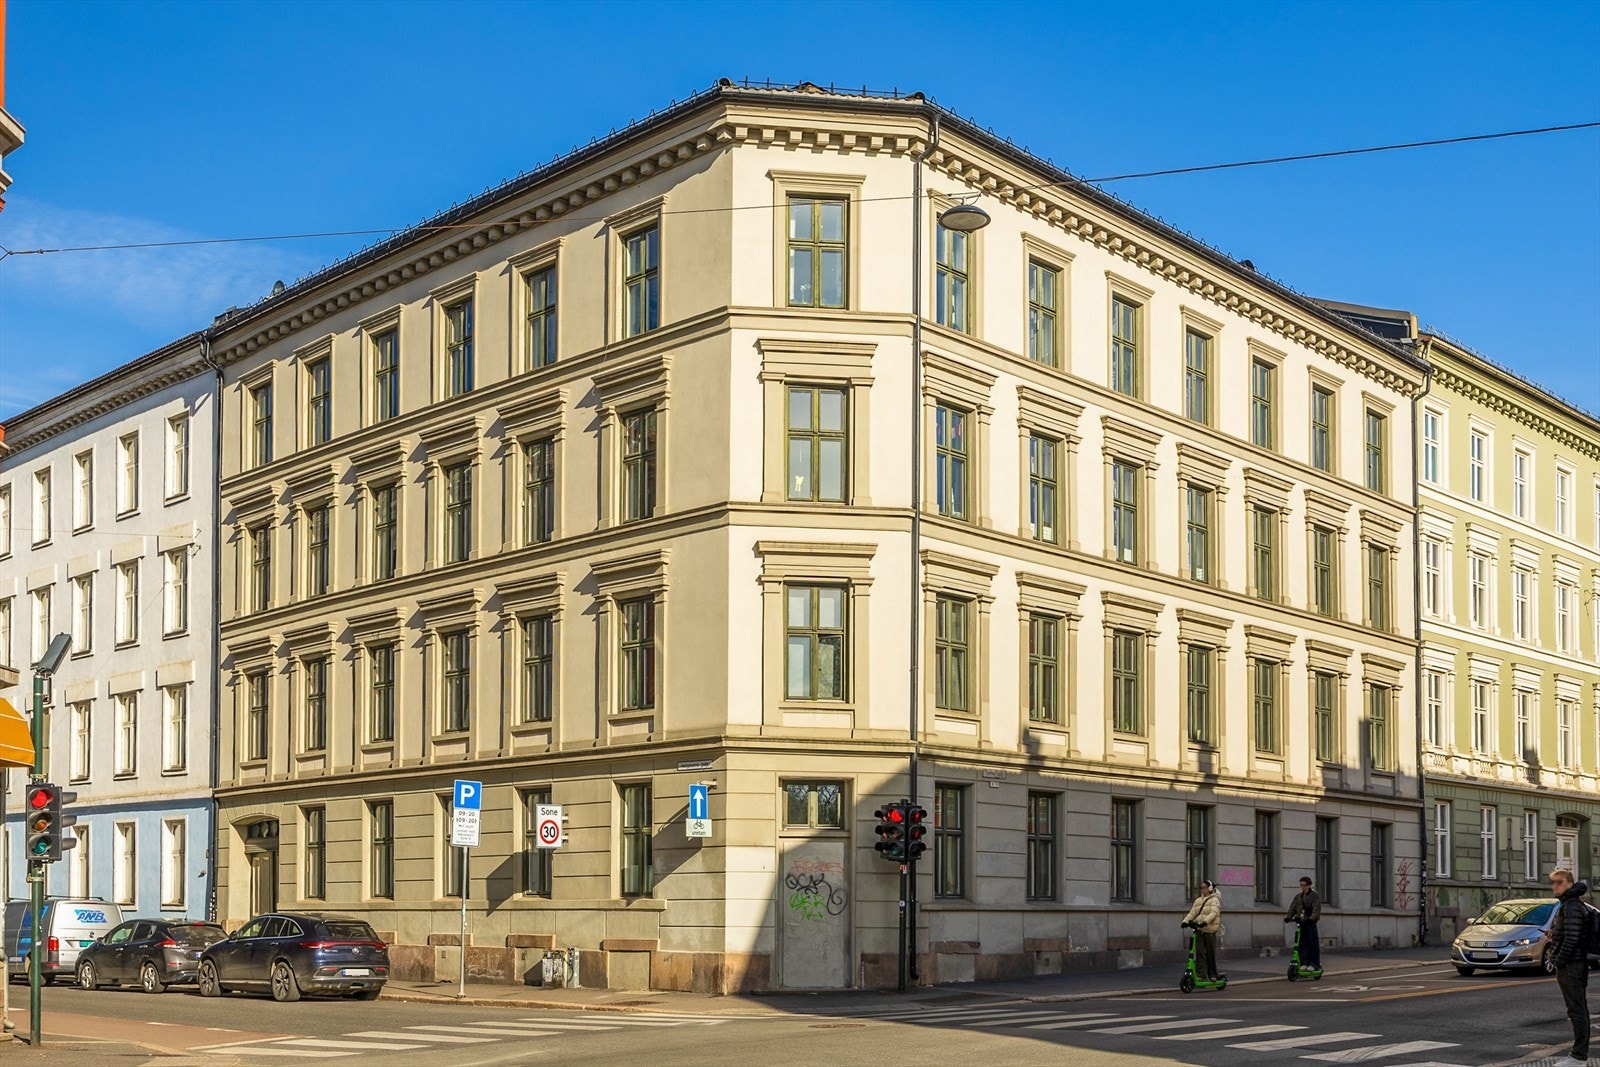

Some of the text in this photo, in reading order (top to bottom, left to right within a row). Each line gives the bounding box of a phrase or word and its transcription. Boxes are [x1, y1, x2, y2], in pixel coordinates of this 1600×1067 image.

[460, 784, 475, 805] P
[541, 807, 558, 816] Sone
[543, 826, 556, 838] 30
